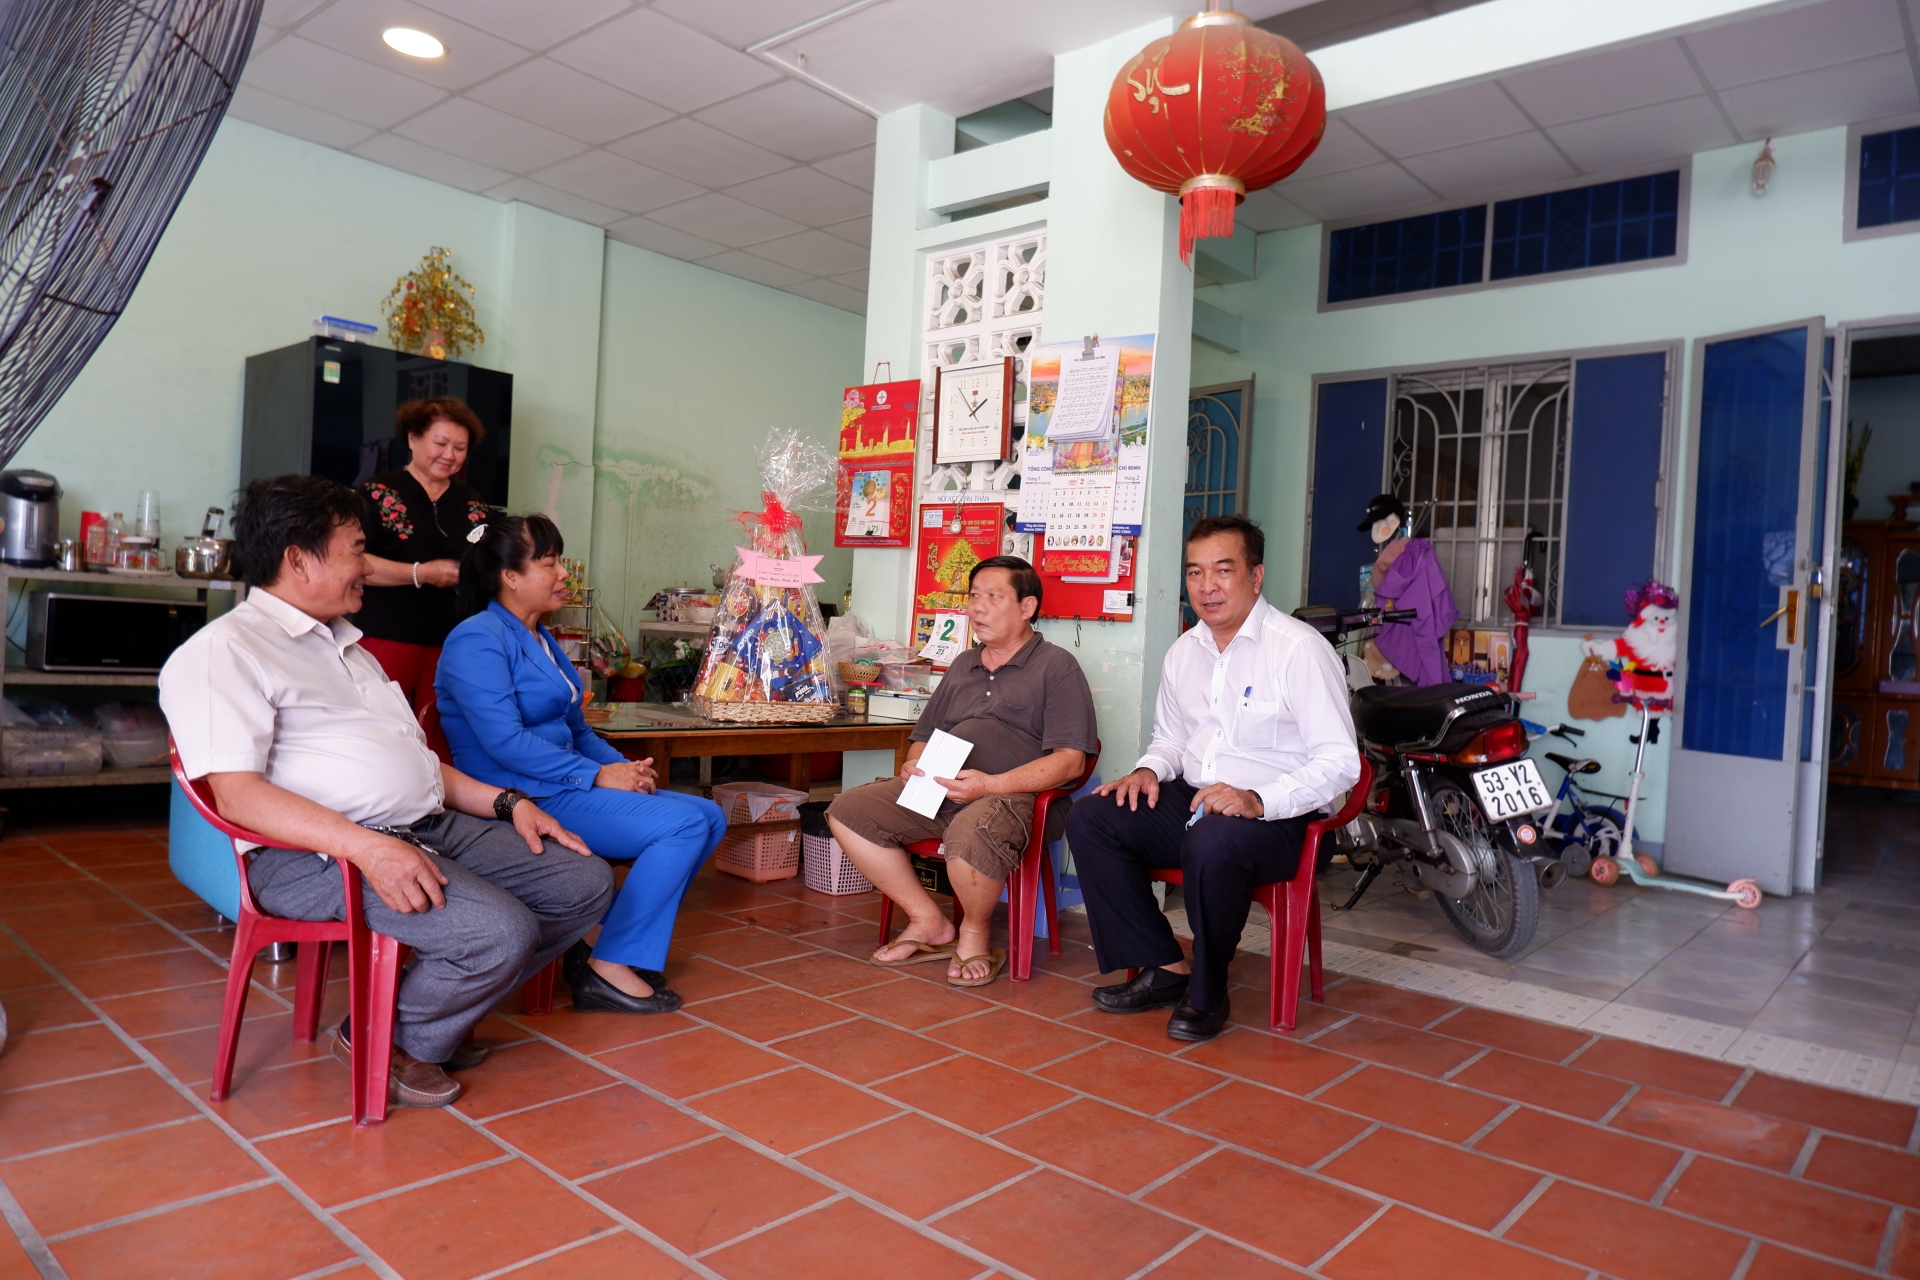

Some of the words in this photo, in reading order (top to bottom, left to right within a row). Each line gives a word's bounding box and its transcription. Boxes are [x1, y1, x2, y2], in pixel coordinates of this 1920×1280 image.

[972, 378, 980, 388] 12
[949, 411, 954, 419] 9
[949, 426, 953, 435] 8
[960, 439, 964, 448] 7
[970, 438, 975, 447] 6
[865, 498, 878, 516] 2
[940, 619, 955, 642] 2
[1454, 690, 1493, 704] HONDA
[1481, 764, 1532, 794] 53-Y2
[1492, 787, 1542, 816] 2016
